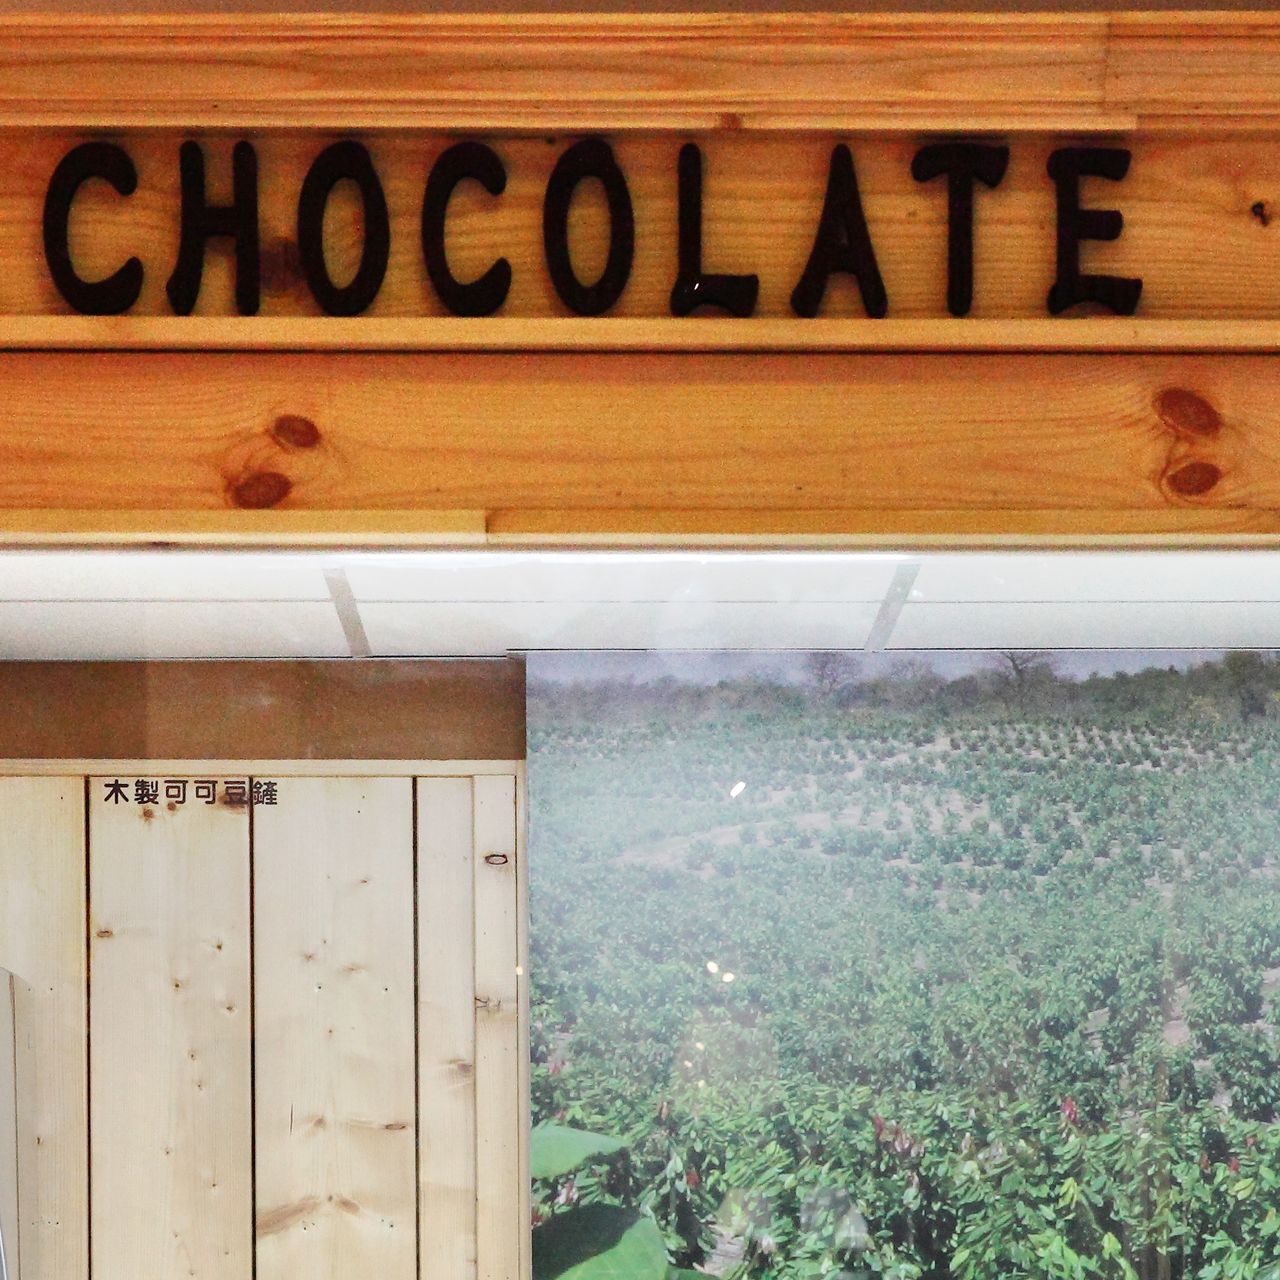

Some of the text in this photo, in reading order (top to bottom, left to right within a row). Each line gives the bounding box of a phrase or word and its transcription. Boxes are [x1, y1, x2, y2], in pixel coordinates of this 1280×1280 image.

[42, 138, 1143, 317] CHOCOLATE
[103, 778, 278, 806] 木製可可豆鏟
